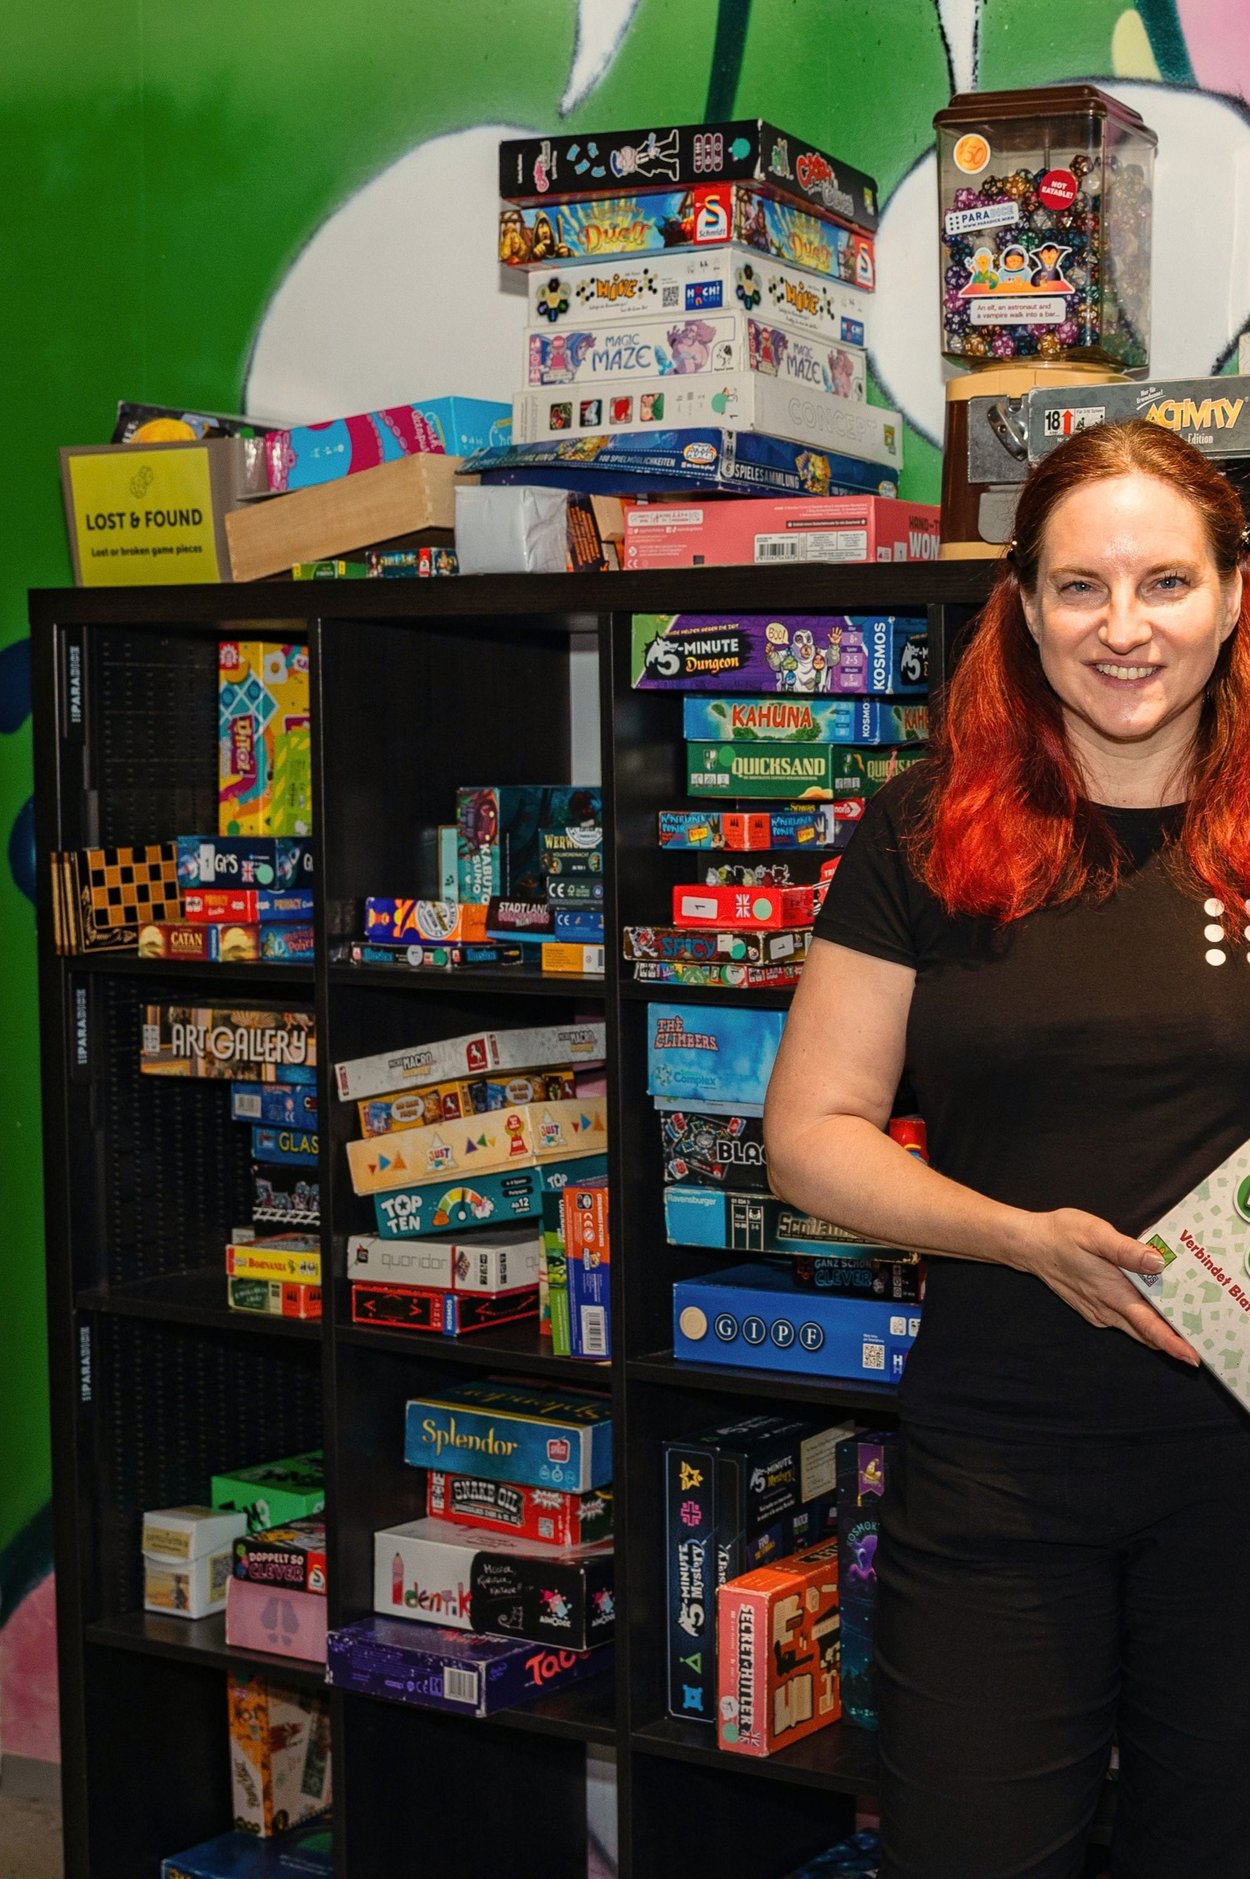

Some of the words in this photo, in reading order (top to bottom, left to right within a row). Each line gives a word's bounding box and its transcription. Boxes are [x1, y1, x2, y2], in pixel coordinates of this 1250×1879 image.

[1041, 187, 1074, 199] EATABLE!
[1051, 180, 1067, 190] NOT
[699, 228, 725, 238] Schmidt
[987, 304, 997, 312] elf,
[605, 333, 640, 347] MAGIC
[592, 346, 652, 372] MAZE
[786, 355, 821, 384] MAZE
[788, 398, 877, 444] CONCEPT
[1046, 409, 1061, 430] 18
[1145, 398, 1244, 430] ACTIVITY
[1187, 434, 1214, 445] Edition
[86, 512, 125, 531] LOST
[130, 512, 140, 528] &
[145, 509, 203, 527] FOUND
[92, 548, 108, 557] Lost
[121, 547, 150, 555] broken
[152, 548, 173, 557] game
[177, 545, 202, 554] pieces
[685, 656, 740, 676] Dungeon
[845, 655, 858, 665] 2-5
[873, 622, 886, 690] KOSMOS
[731, 704, 813, 729] KAHUNA
[862, 697, 871, 738] KOSMOS
[731, 757, 826, 778] QUICKSAND
[472, 855, 482, 894] SUMO
[480, 844, 492, 904] KABUTO
[171, 932, 203, 945] CATAN
[172, 1024, 208, 1057] ART
[211, 1026, 306, 1064] GALLERY
[654, 1032, 719, 1052] CLIMBERS
[673, 1071, 718, 1088] Complex
[540, 1124, 559, 1136] JUST
[429, 1148, 449, 1161] JUST
[381, 1194, 423, 1219] TOP
[518, 1198, 529, 1208] 12
[387, 1216, 421, 1235] TEN
[1179, 1229, 1232, 1286] Verbindet
[814, 1269, 872, 1287] CLEVER
[421, 1418, 522, 1456] Splendor
[454, 1481, 495, 1502] SNAKE
[497, 1487, 518, 1512] OIL
[249, 1552, 289, 1563] DOPPELT
[291, 1555, 304, 1565] SO
[249, 1563, 304, 1582] CLEVER
